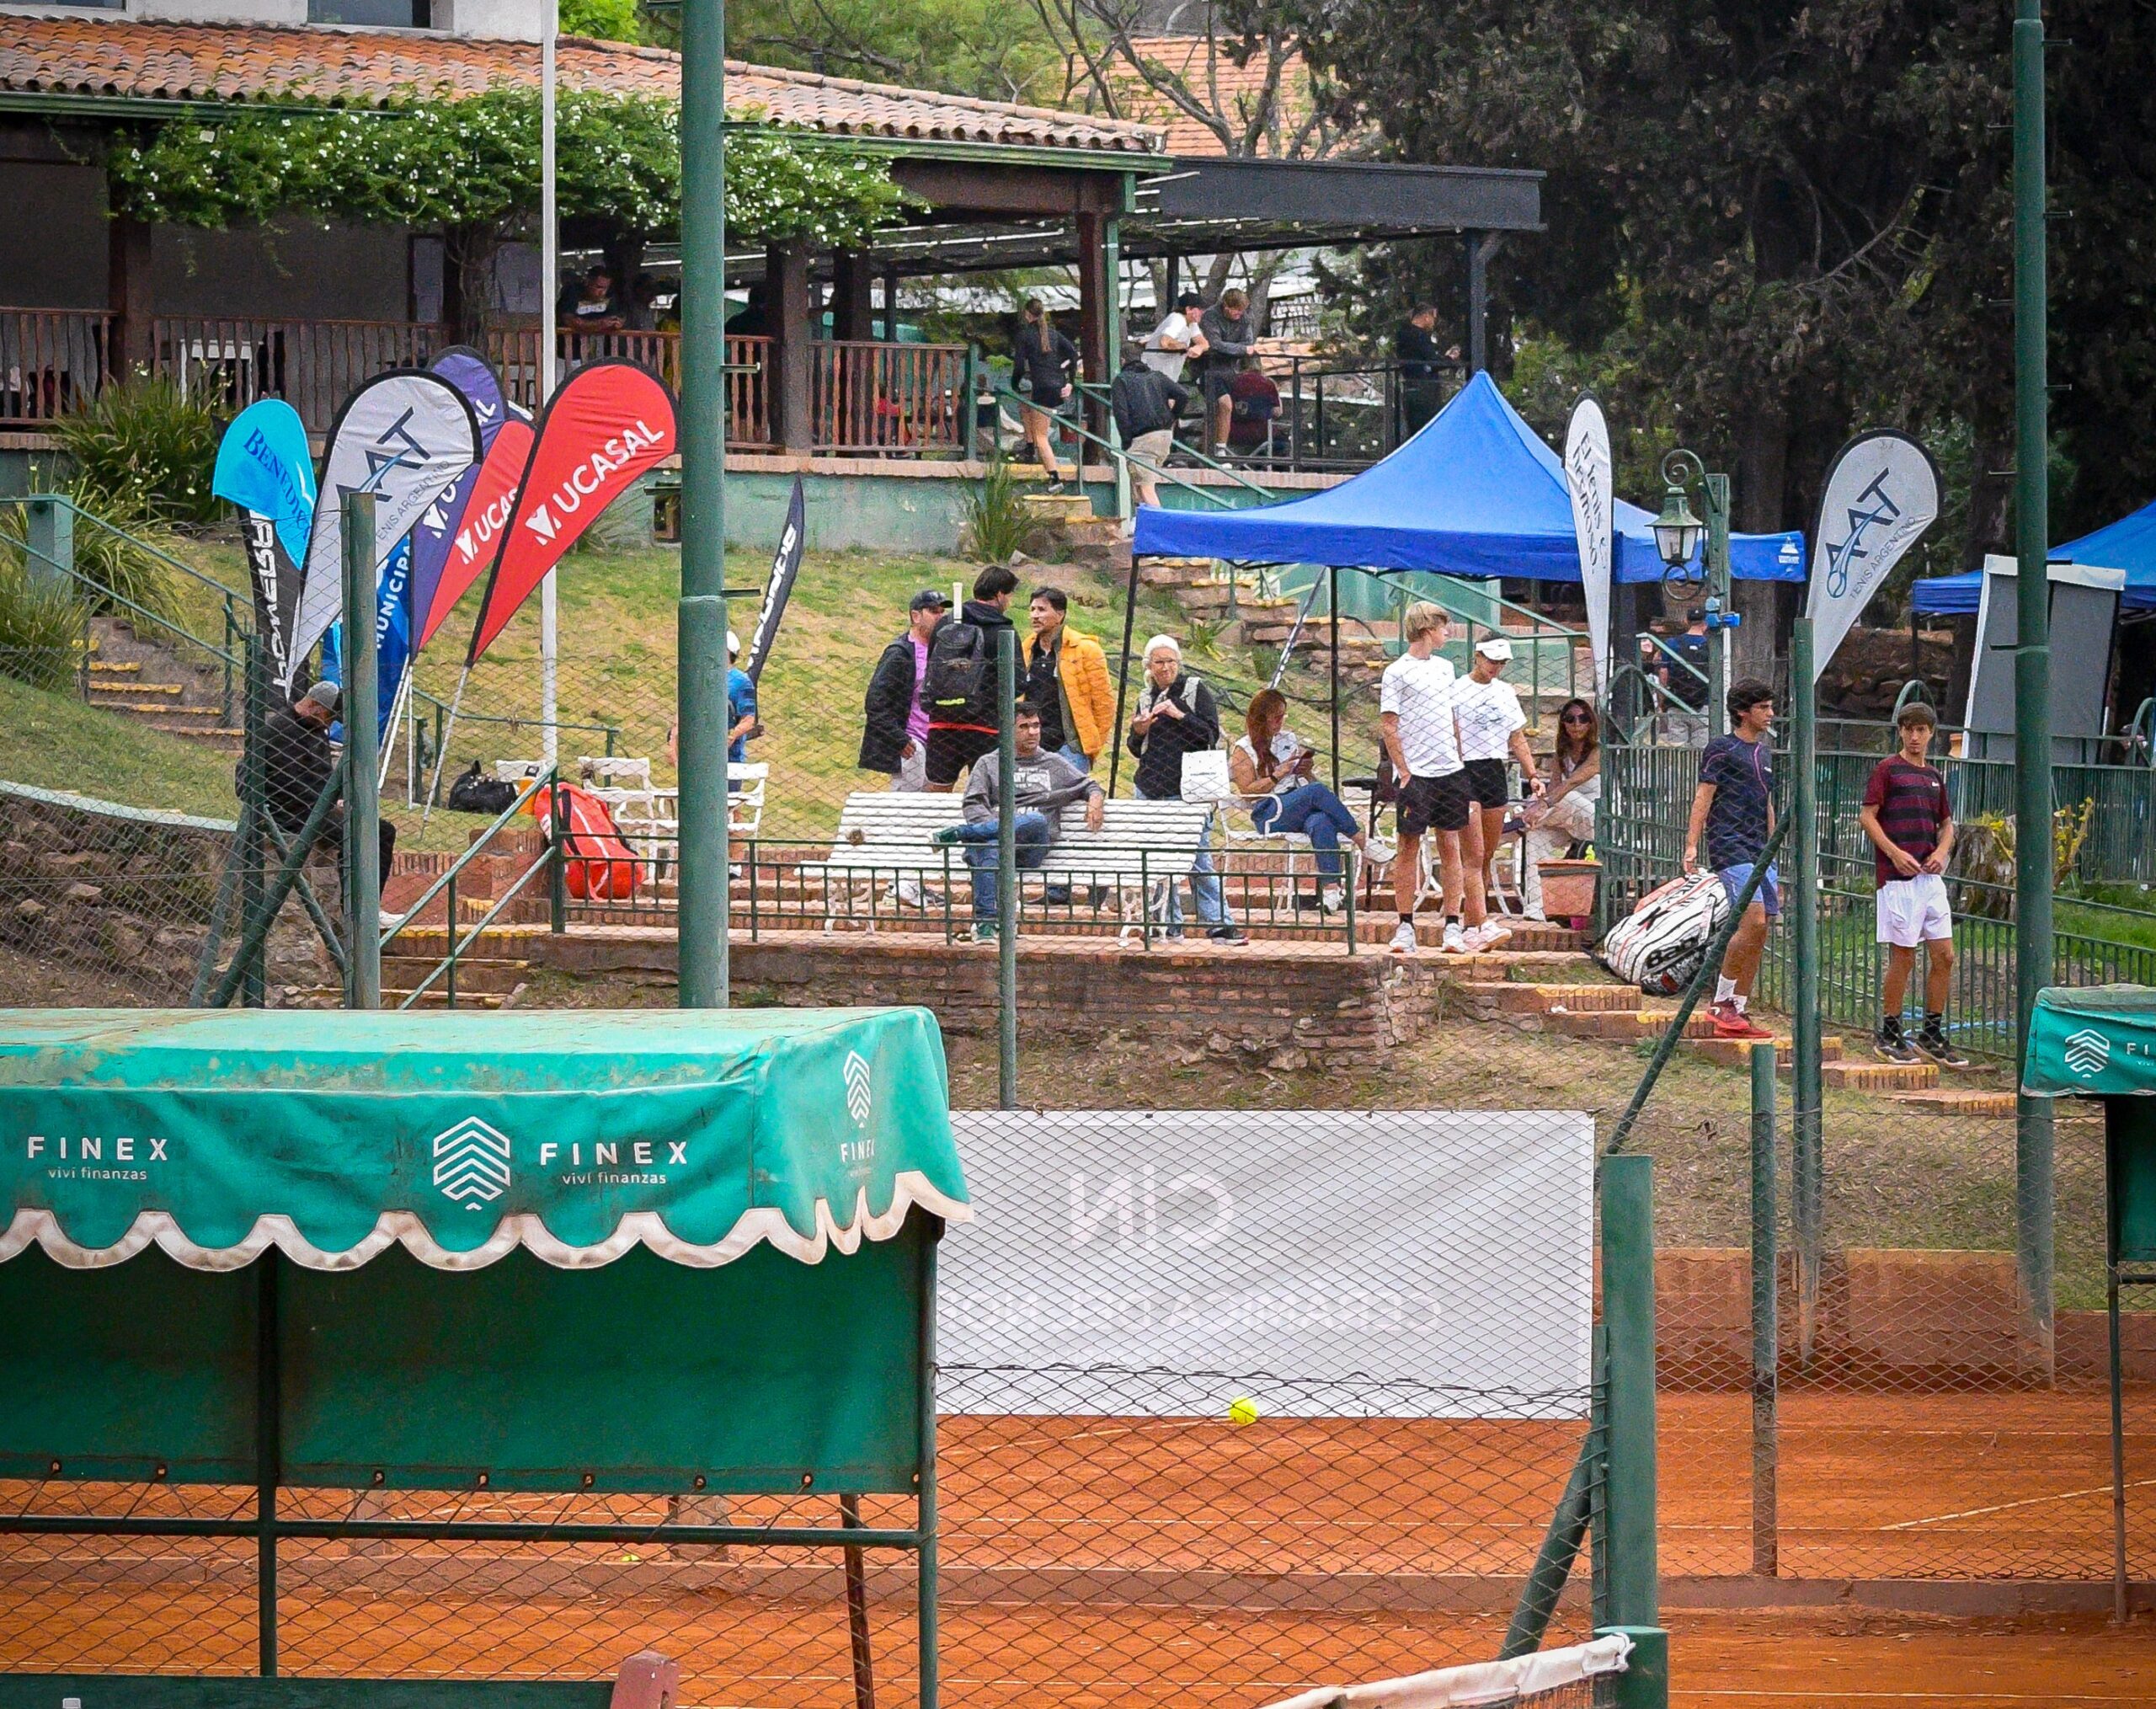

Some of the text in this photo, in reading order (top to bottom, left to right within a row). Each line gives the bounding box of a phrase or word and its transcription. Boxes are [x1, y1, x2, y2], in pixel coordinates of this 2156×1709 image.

[552, 420, 664, 513] UCASAL
[376, 514, 400, 542] ENIS
[1825, 467, 1901, 571] AAT
[1849, 516, 1916, 600] TENIS ARGENTINO
[28, 1136, 168, 1161] FINEX
[540, 1141, 687, 1166] FINEX
[81, 1166, 147, 1180] finanzas
[598, 1171, 667, 1185] finanzas
